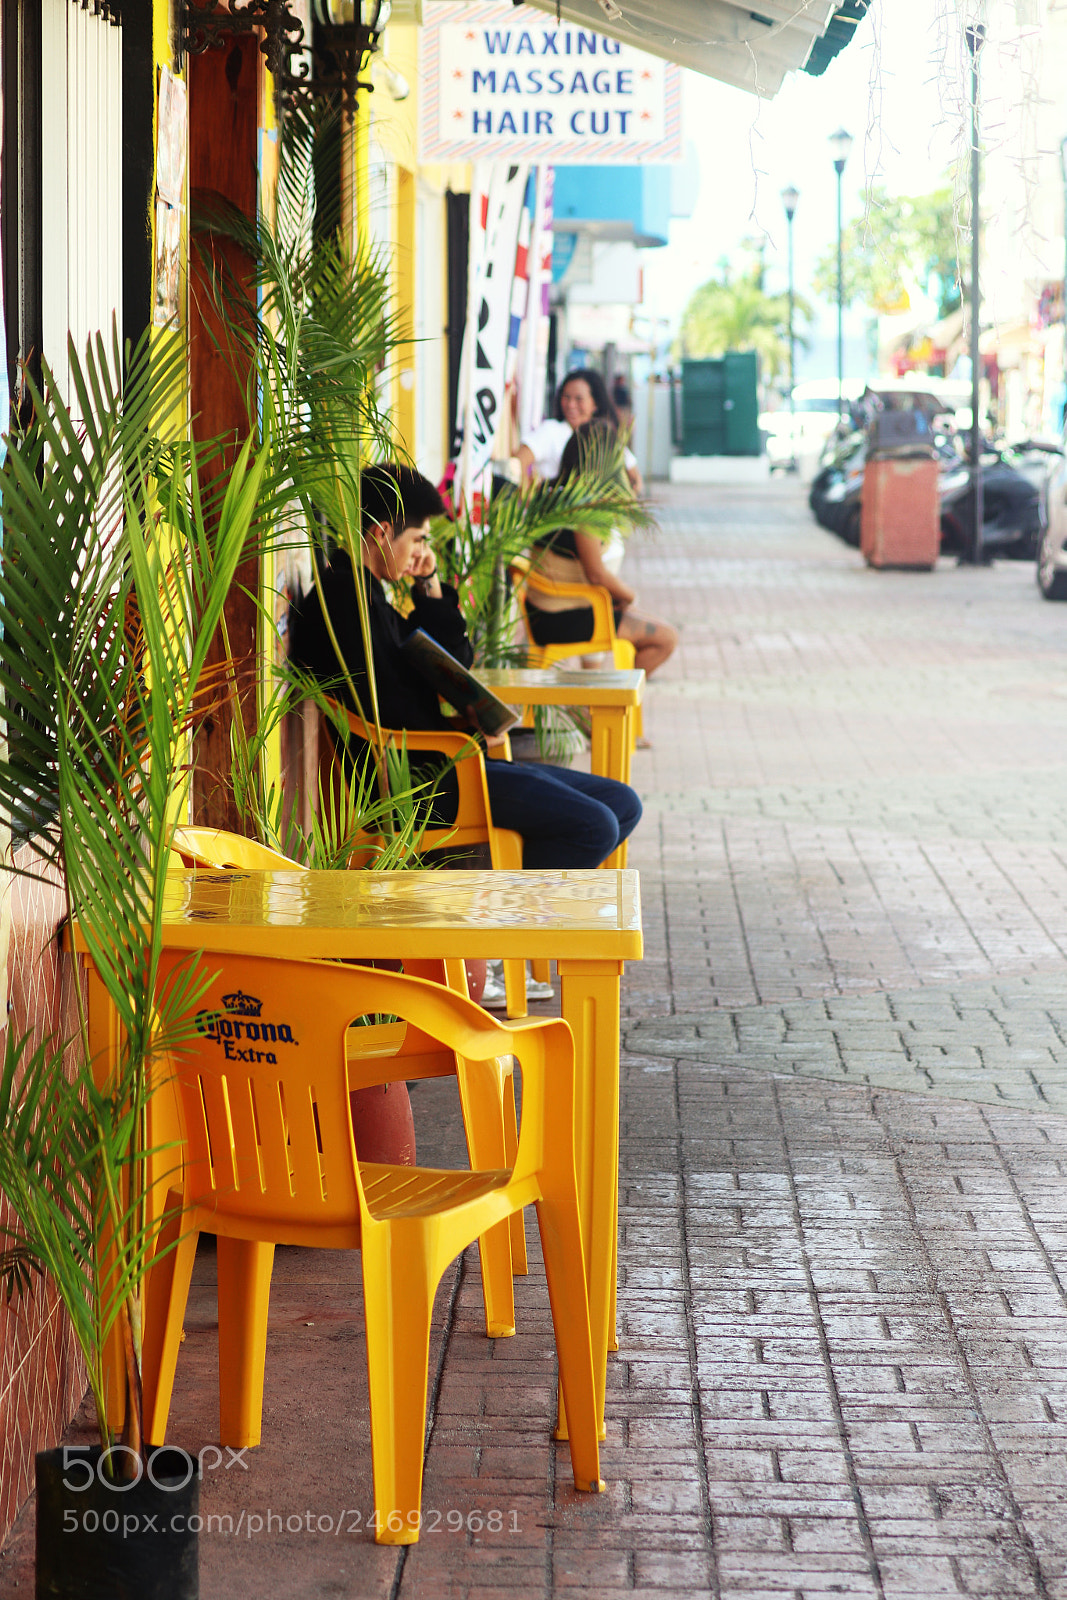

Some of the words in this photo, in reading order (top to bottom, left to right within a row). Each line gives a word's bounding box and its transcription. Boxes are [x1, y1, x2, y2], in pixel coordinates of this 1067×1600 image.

[484, 30, 621, 55] WAXING
[472, 70, 634, 94] MASSAGE
[472, 110, 554, 135] HAIR
[570, 110, 633, 135] CUT
[223, 1040, 277, 1065] Extra
